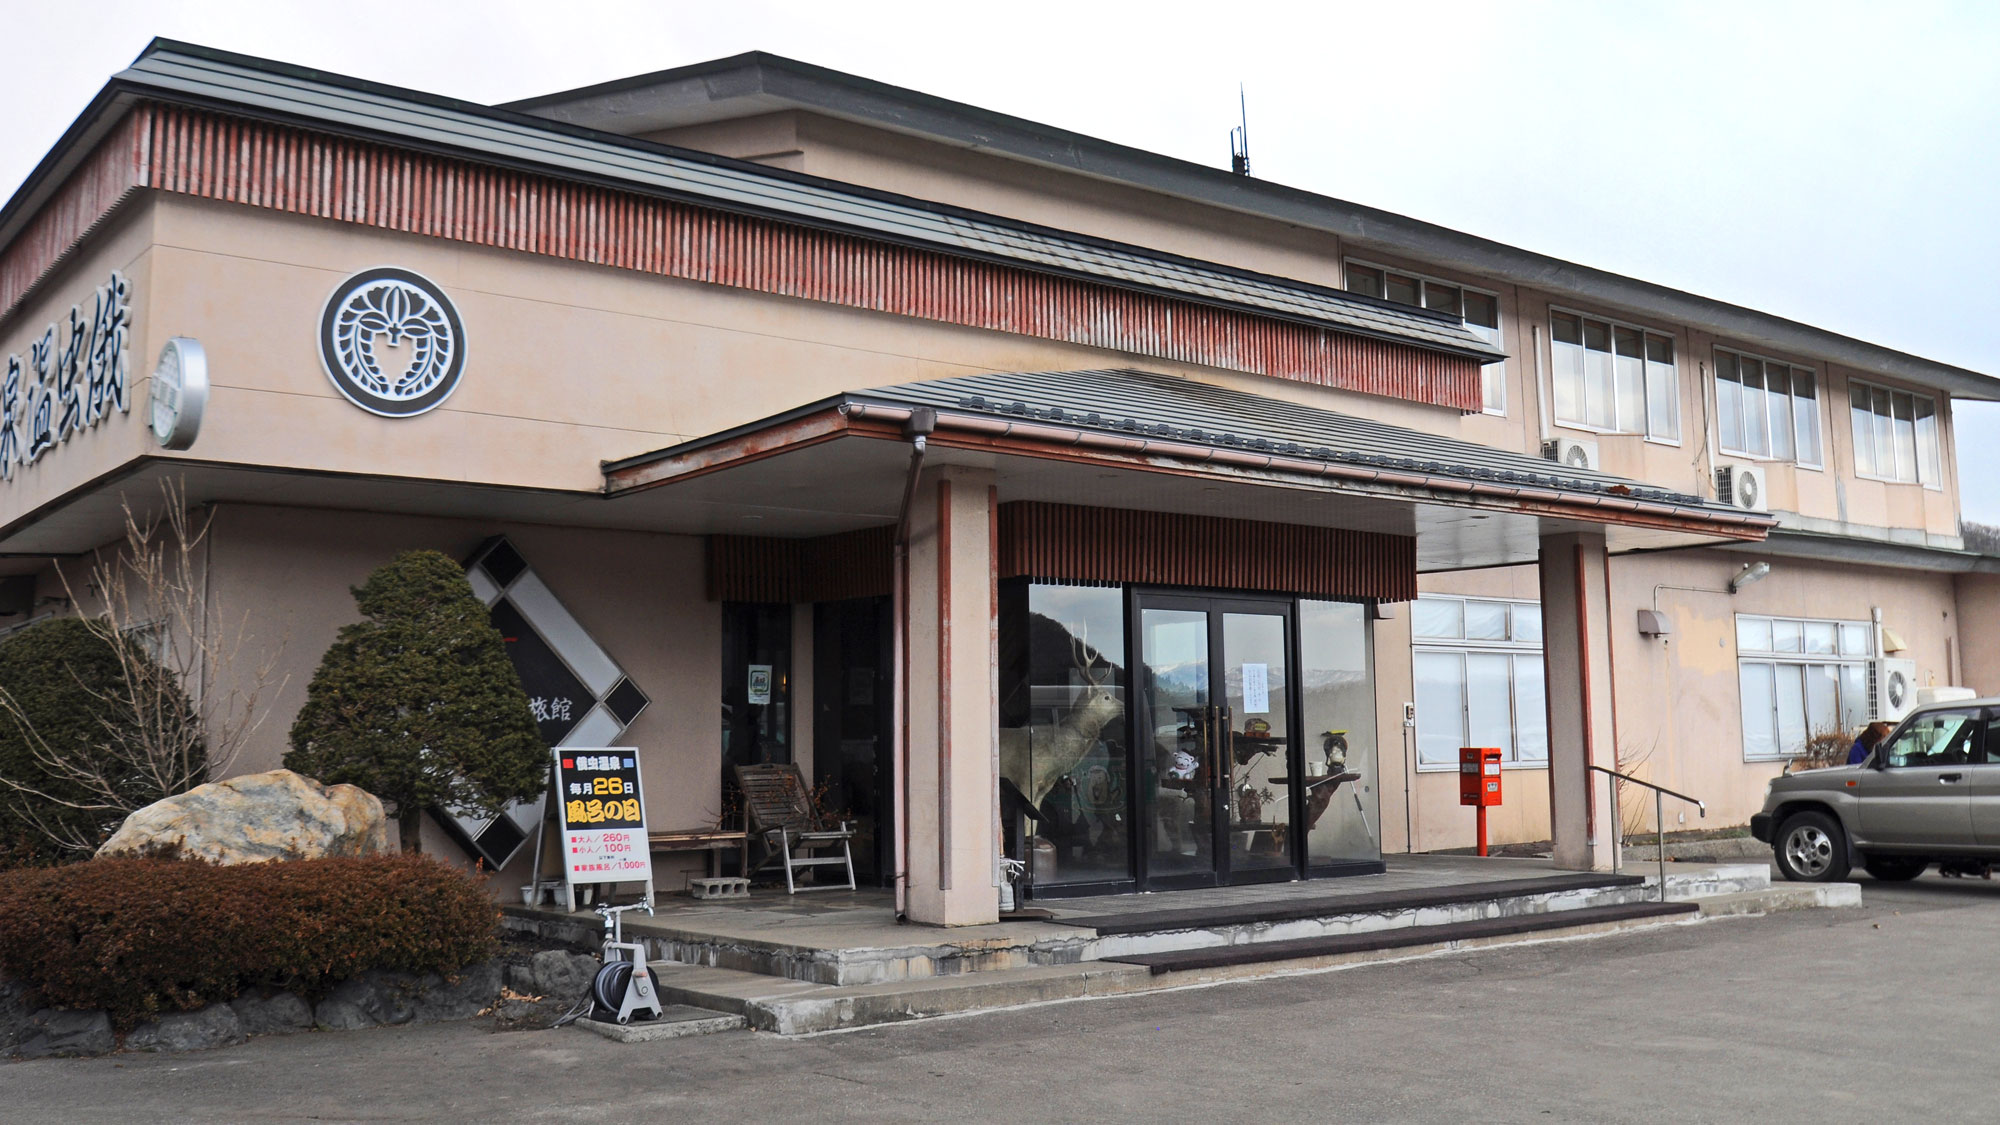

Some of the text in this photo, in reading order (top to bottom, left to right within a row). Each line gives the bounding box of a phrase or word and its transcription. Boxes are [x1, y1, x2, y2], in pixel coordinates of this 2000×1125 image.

[570, 777, 634, 795] 毎月26日
[566, 798, 641, 823] 風呂の日
